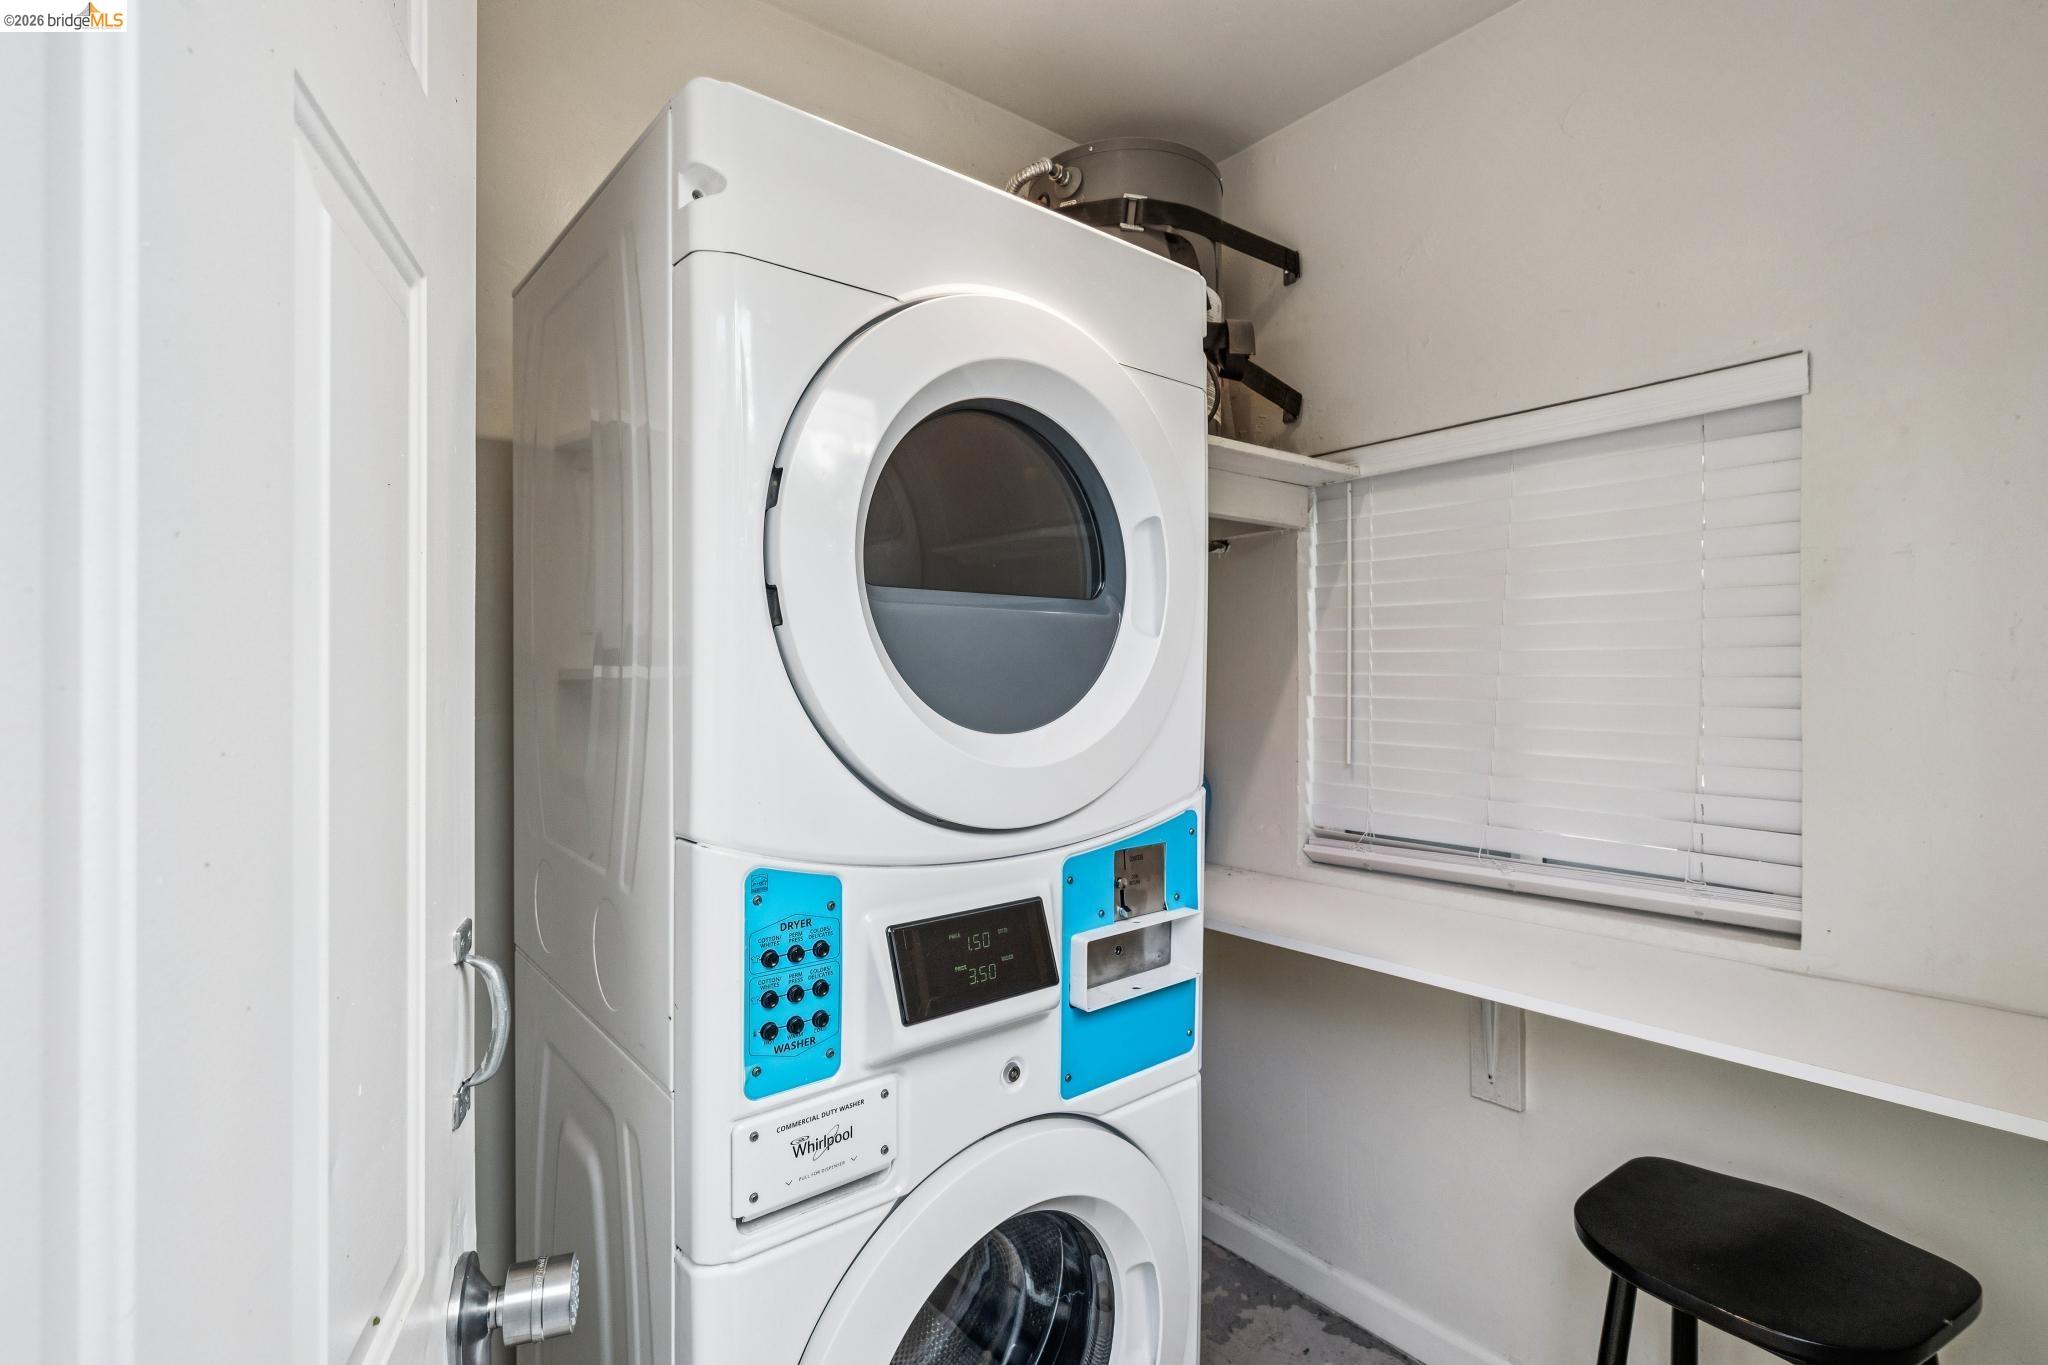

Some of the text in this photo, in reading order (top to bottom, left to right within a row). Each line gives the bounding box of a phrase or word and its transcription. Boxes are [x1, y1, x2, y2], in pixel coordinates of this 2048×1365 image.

[780, 918, 812, 932] DRYER
[808, 931, 834, 940] DELICATES
[760, 941, 780, 949] WHITES
[808, 971, 834, 980] DELICATES
[968, 963, 997, 985] 3.50
[760, 982, 780, 990] WHITES
[773, 1036, 816, 1054] WASHER
[776, 1098, 865, 1134] COMMERCIAL DUTY WASHER
[792, 1125, 853, 1158] Whirlpool
